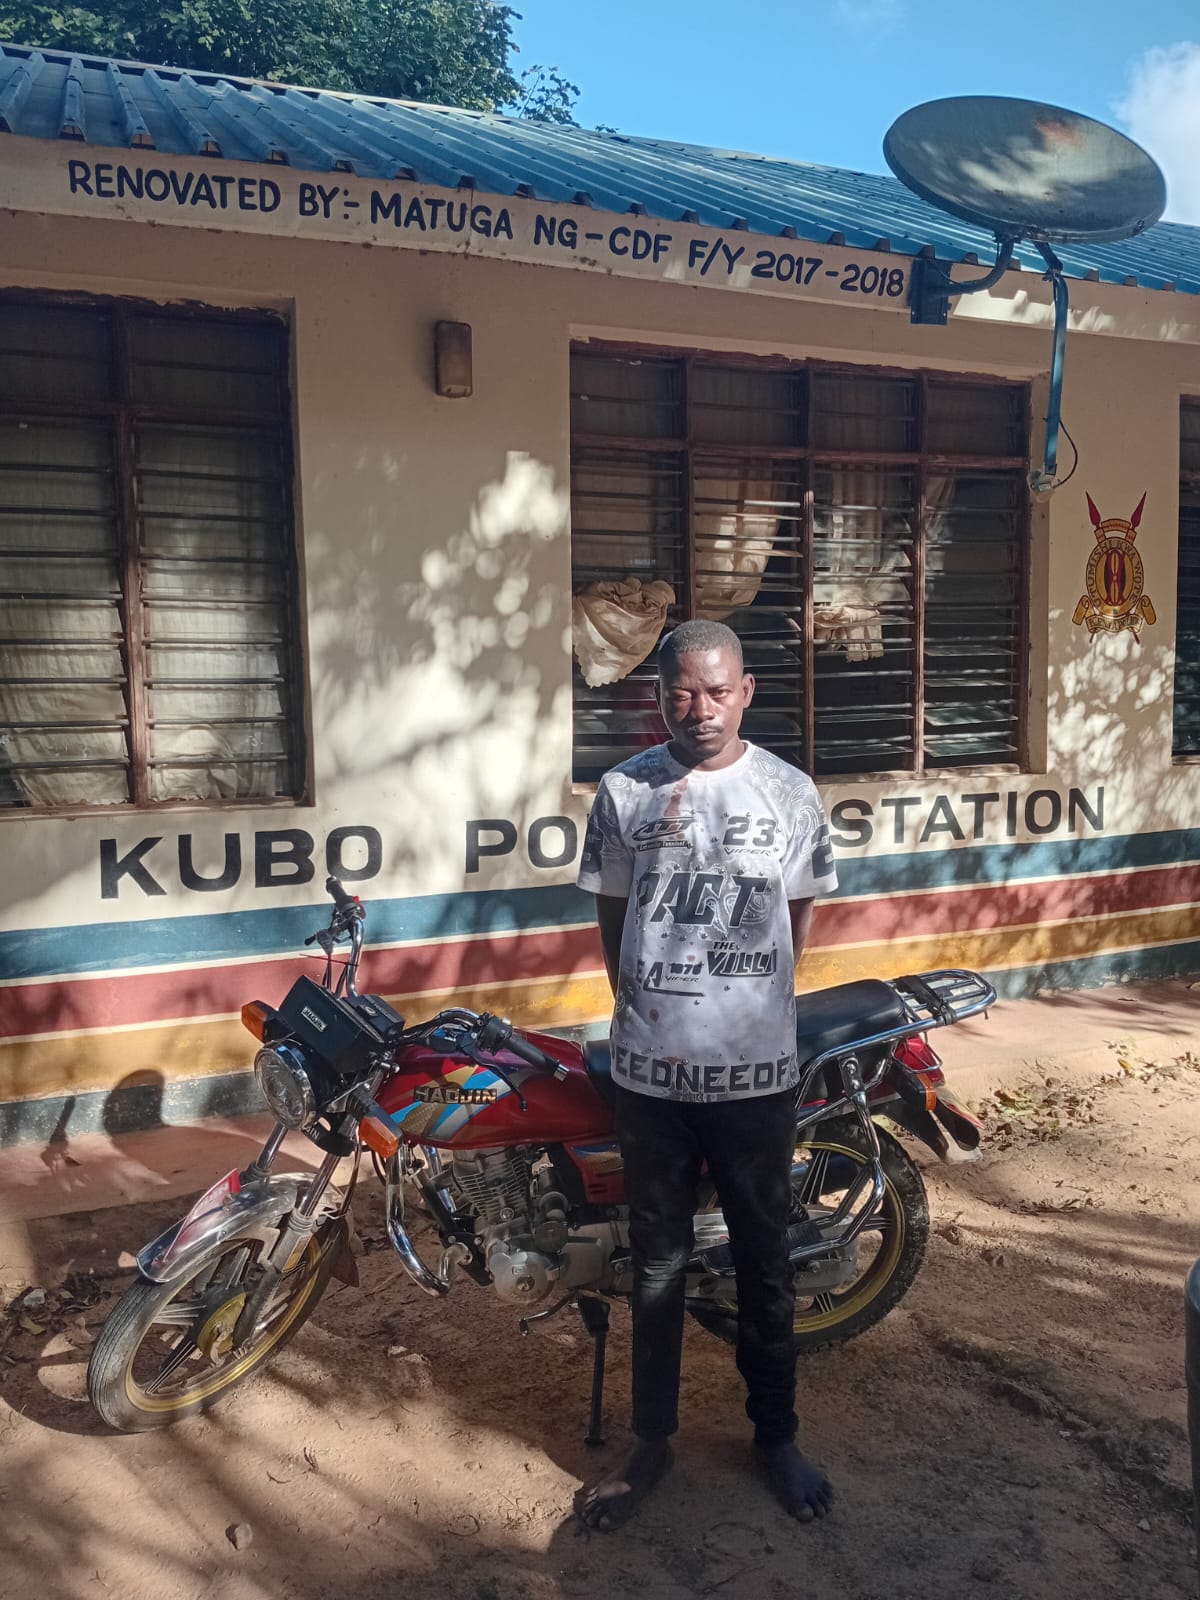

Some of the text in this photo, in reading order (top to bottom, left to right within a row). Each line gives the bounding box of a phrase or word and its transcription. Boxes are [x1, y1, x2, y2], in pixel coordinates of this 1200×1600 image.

[68, 158, 281, 213] RENOVATED
[370, 191, 514, 240] MATUGA
[688, 237, 745, 275] F/Y
[750, 250, 904, 297] 2017-2018
[100, 825, 383, 900] KUBO
[466, 815, 583, 874] PO
[829, 786, 1105, 848] STATION
[722, 815, 777, 847] 23
[723, 847, 773, 857] VIPER
[713, 941, 736, 951] THE
